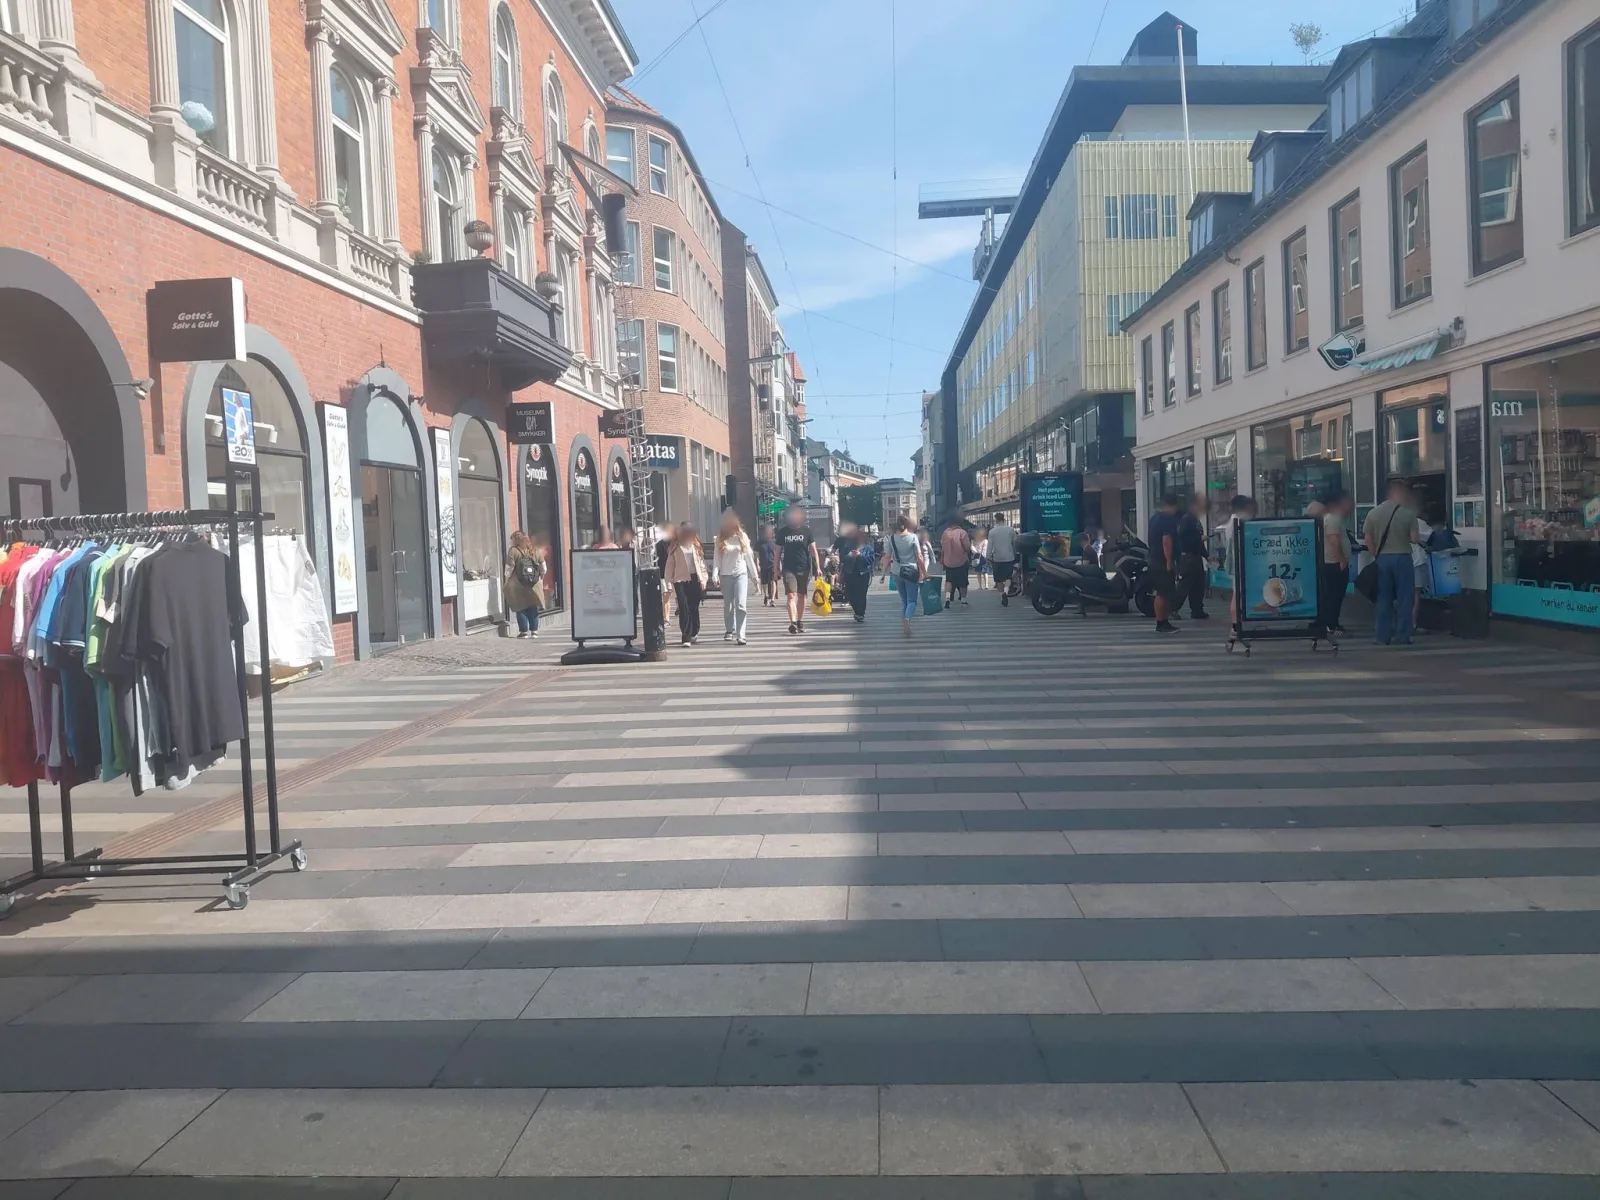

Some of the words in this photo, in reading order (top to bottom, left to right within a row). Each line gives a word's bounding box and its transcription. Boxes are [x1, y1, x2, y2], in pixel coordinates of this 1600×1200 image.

[178, 311, 213, 321] Gotte's
[197, 320, 219, 329] Guld
[518, 430, 546, 438] SMYKKER
[526, 463, 548, 482] Synoptik
[574, 472, 591, 488] Synoptik
[784, 534, 805, 542] HUGO
[1252, 536, 1282, 549] Græd
[1285, 536, 1309, 548] ikke
